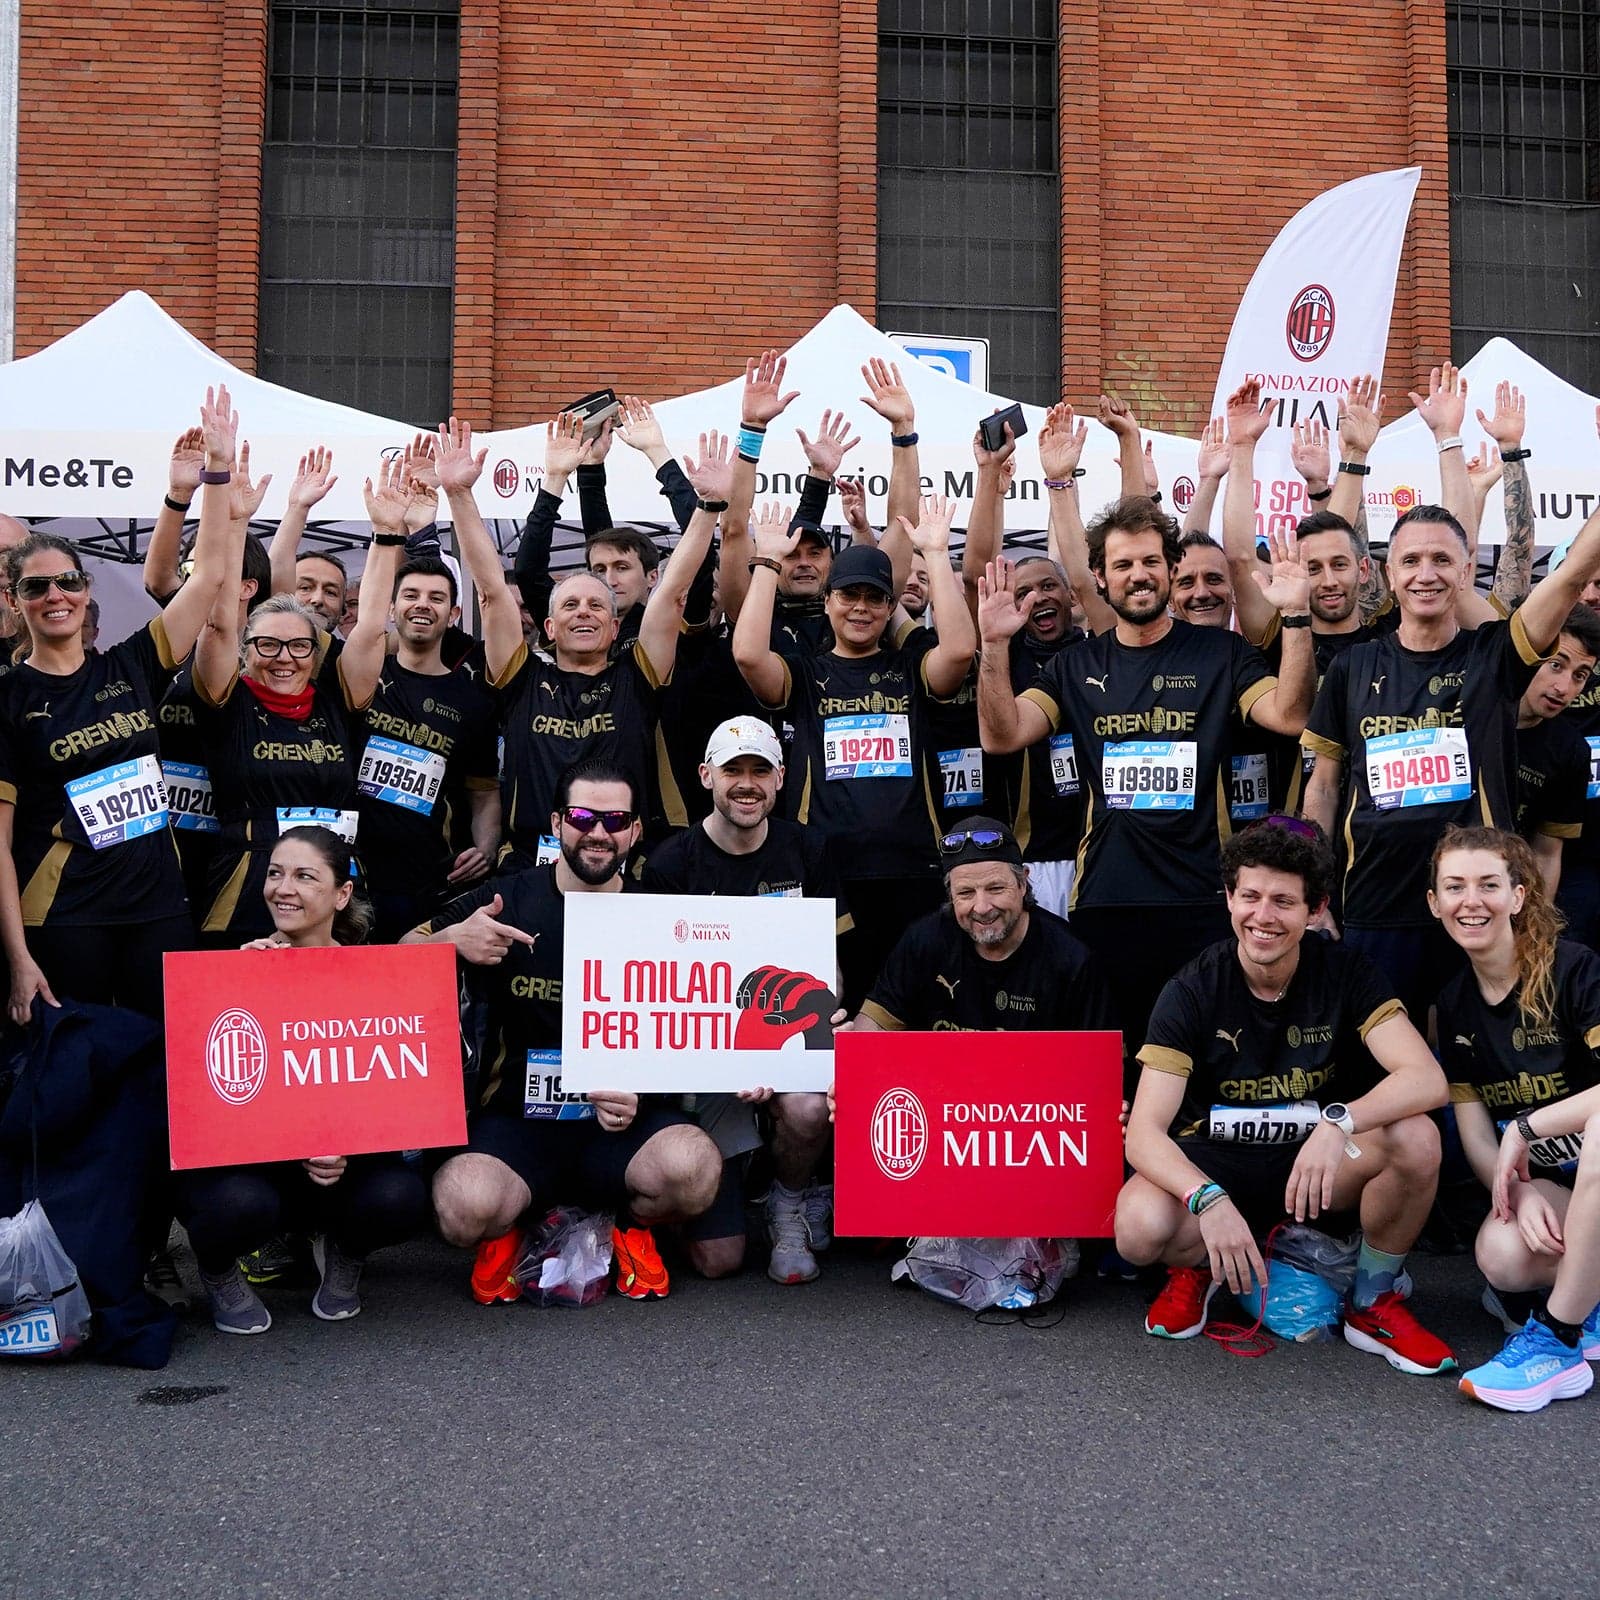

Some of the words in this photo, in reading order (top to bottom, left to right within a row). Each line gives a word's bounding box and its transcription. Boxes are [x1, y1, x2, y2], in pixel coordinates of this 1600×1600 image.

[1300, 290, 1327, 305] ACM
[1296, 343, 1319, 353] 1899
[4, 457, 134, 488] Me&Te
[944, 471, 1040, 500] Man
[1533, 493, 1600, 519] IUT
[1166, 680, 1197, 689] MILAN
[1094, 706, 1196, 736] GRENADE
[840, 737, 895, 762] 1927D
[371, 759, 427, 797] 1935A
[1118, 766, 1178, 792] 1938B
[1383, 755, 1451, 790] 1948D
[1517, 769, 1545, 788] MILAN
[96, 784, 158, 826] 1927C
[692, 930, 731, 941] MILAN
[583, 959, 611, 1003] IL
[624, 960, 732, 1004] MILAN
[221, 1016, 252, 1032] ACM
[281, 1015, 426, 1041] FONDAZIONE
[582, 1011, 639, 1050] PER
[650, 1011, 732, 1050] TUTTI
[282, 1042, 429, 1087] MILAN
[538, 1053, 561, 1061] UniCre
[223, 1081, 253, 1093] 1899
[1477, 1072, 1570, 1108] RENADE
[535, 1106, 553, 1114] asics
[886, 1095, 914, 1109] ACM
[943, 1103, 1087, 1122] FONDAZIONE
[1231, 1120, 1299, 1144] 1947B
[943, 1130, 1088, 1167] MILAN
[886, 1158, 913, 1169] 1899
